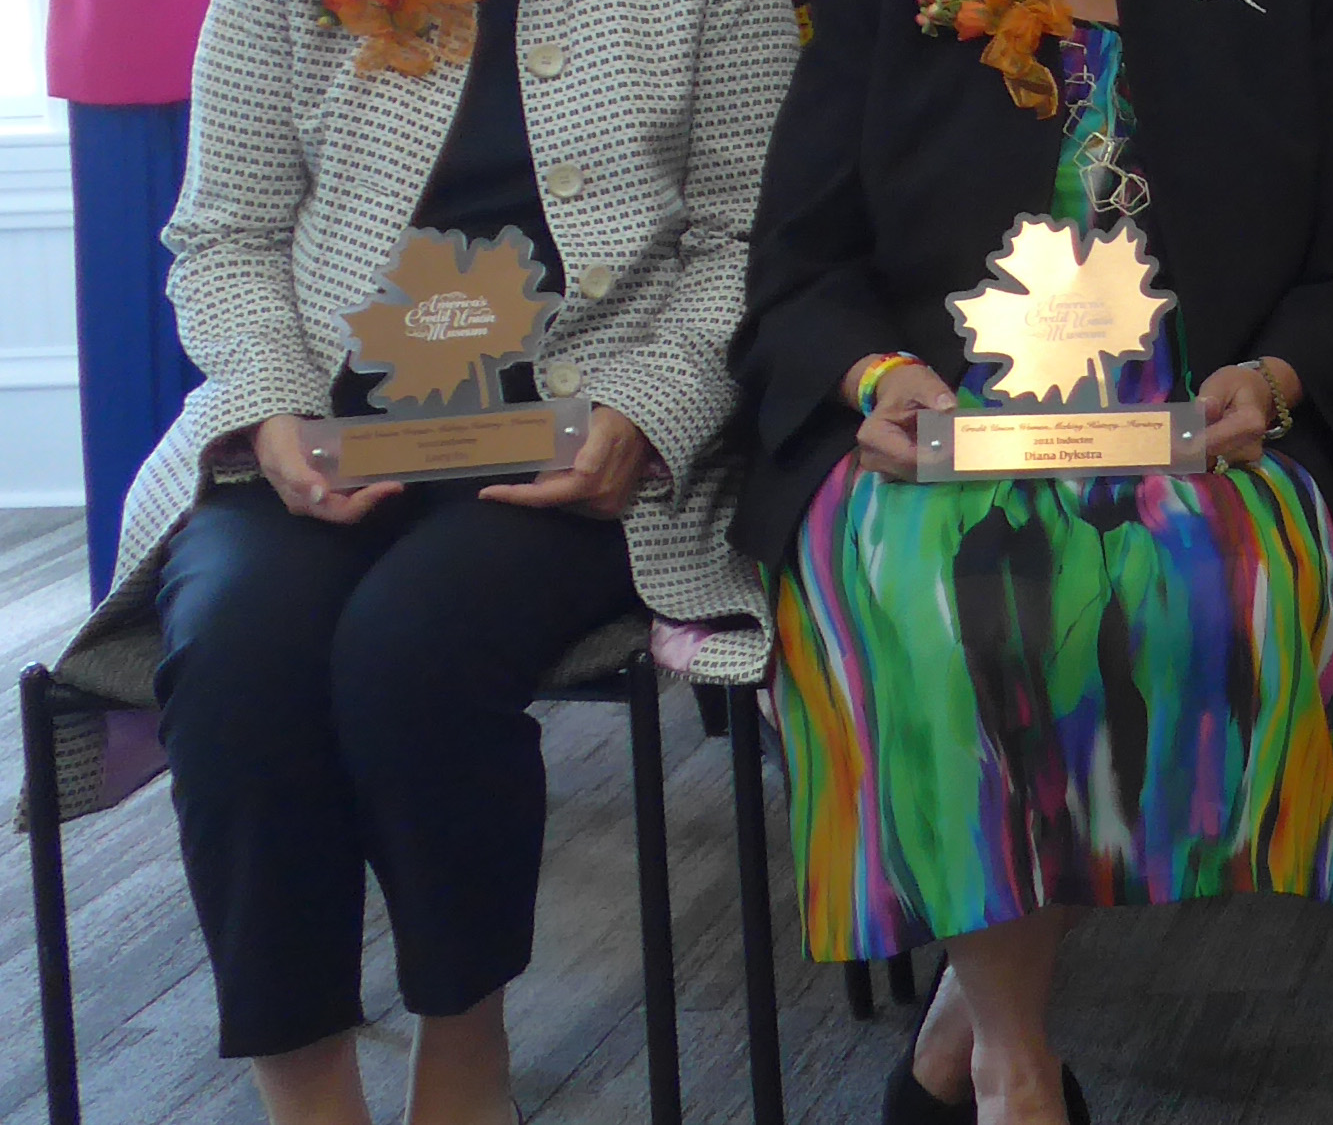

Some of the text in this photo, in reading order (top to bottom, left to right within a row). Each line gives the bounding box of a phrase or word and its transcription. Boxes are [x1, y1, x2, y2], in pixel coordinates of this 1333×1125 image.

[1056, 436, 1094, 445] Inductee
[1024, 449, 1102, 462] Diana Dykstra
